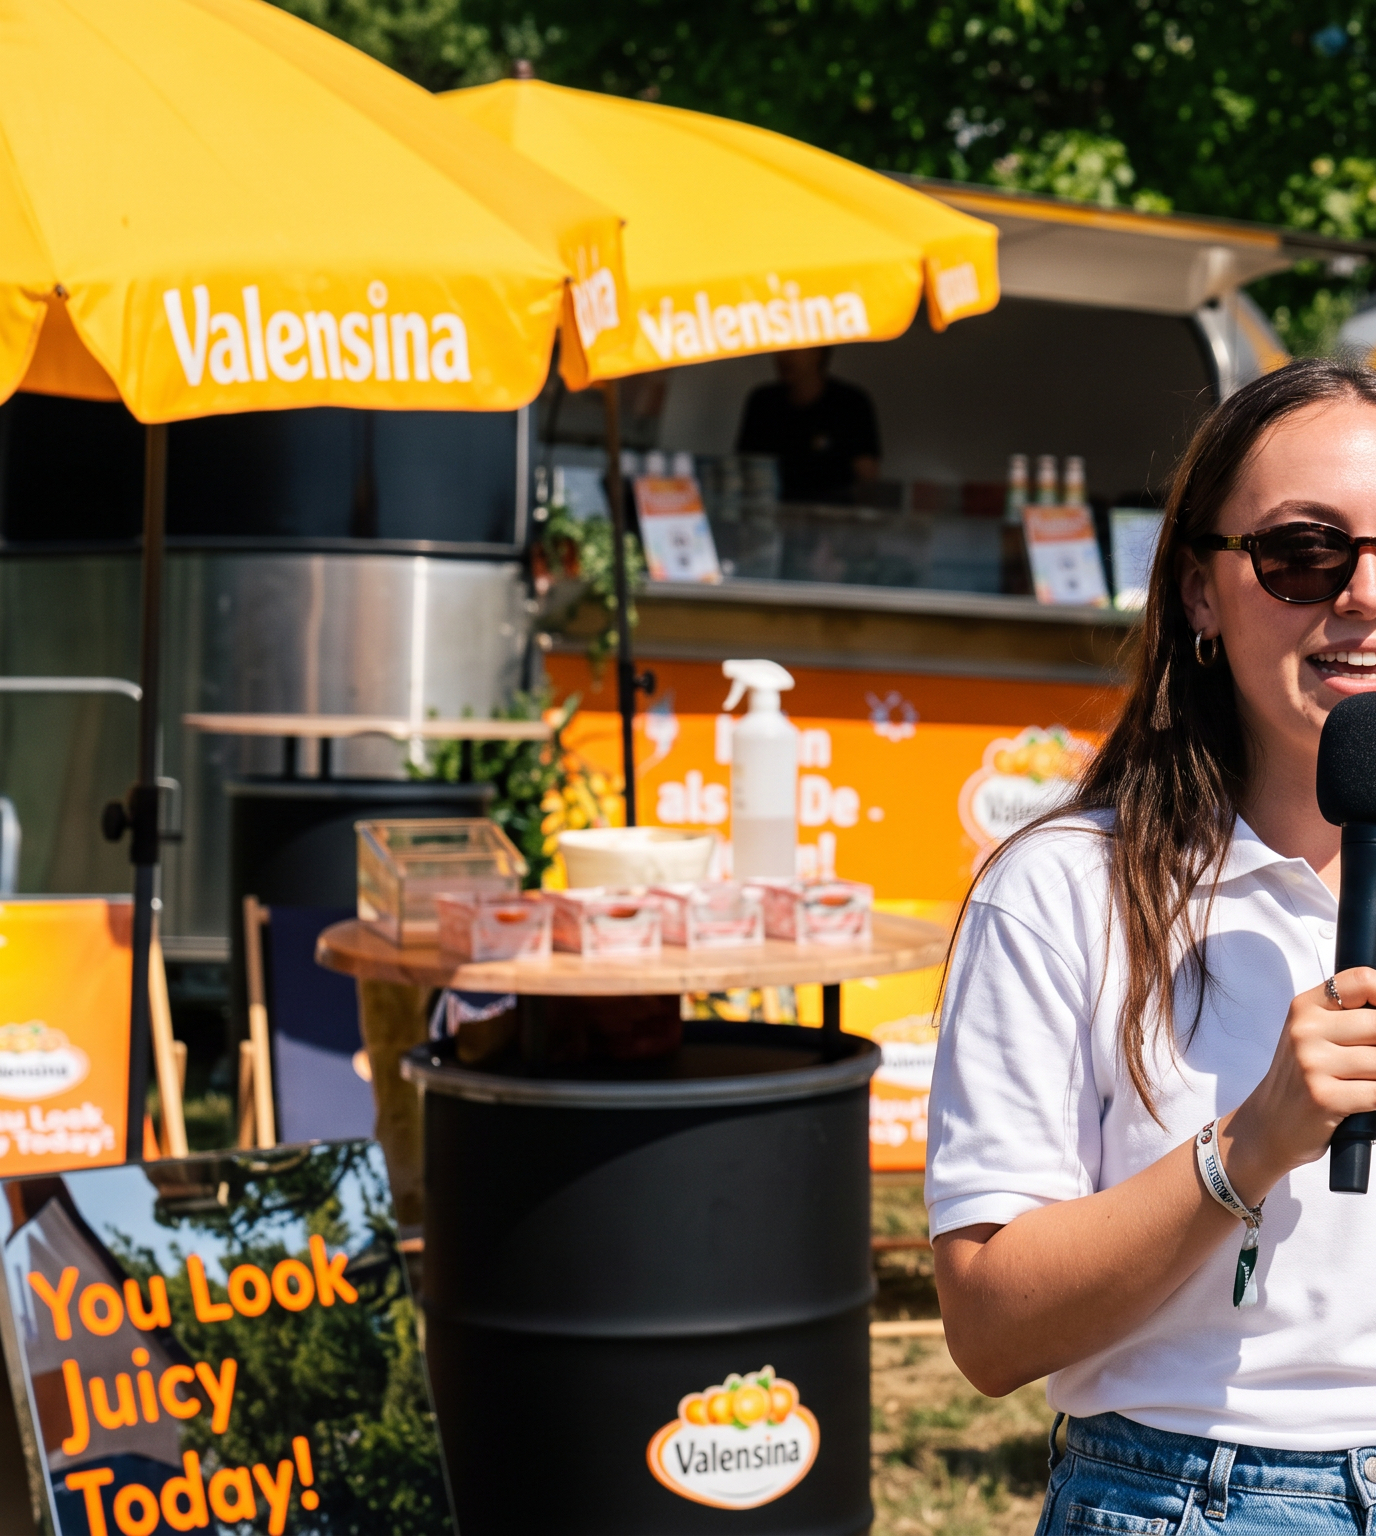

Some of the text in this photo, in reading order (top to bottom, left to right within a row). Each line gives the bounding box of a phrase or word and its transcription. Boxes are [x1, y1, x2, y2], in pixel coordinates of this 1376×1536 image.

[163, 280, 472, 387] Valensina
[638, 279, 871, 361] Valensina
[657, 769, 729, 825] als
[27, 1233, 359, 1341] You Look
[62, 1347, 238, 1456] Juicy
[64, 1435, 320, 1536] Today!
[675, 1434, 800, 1475] Valensina
